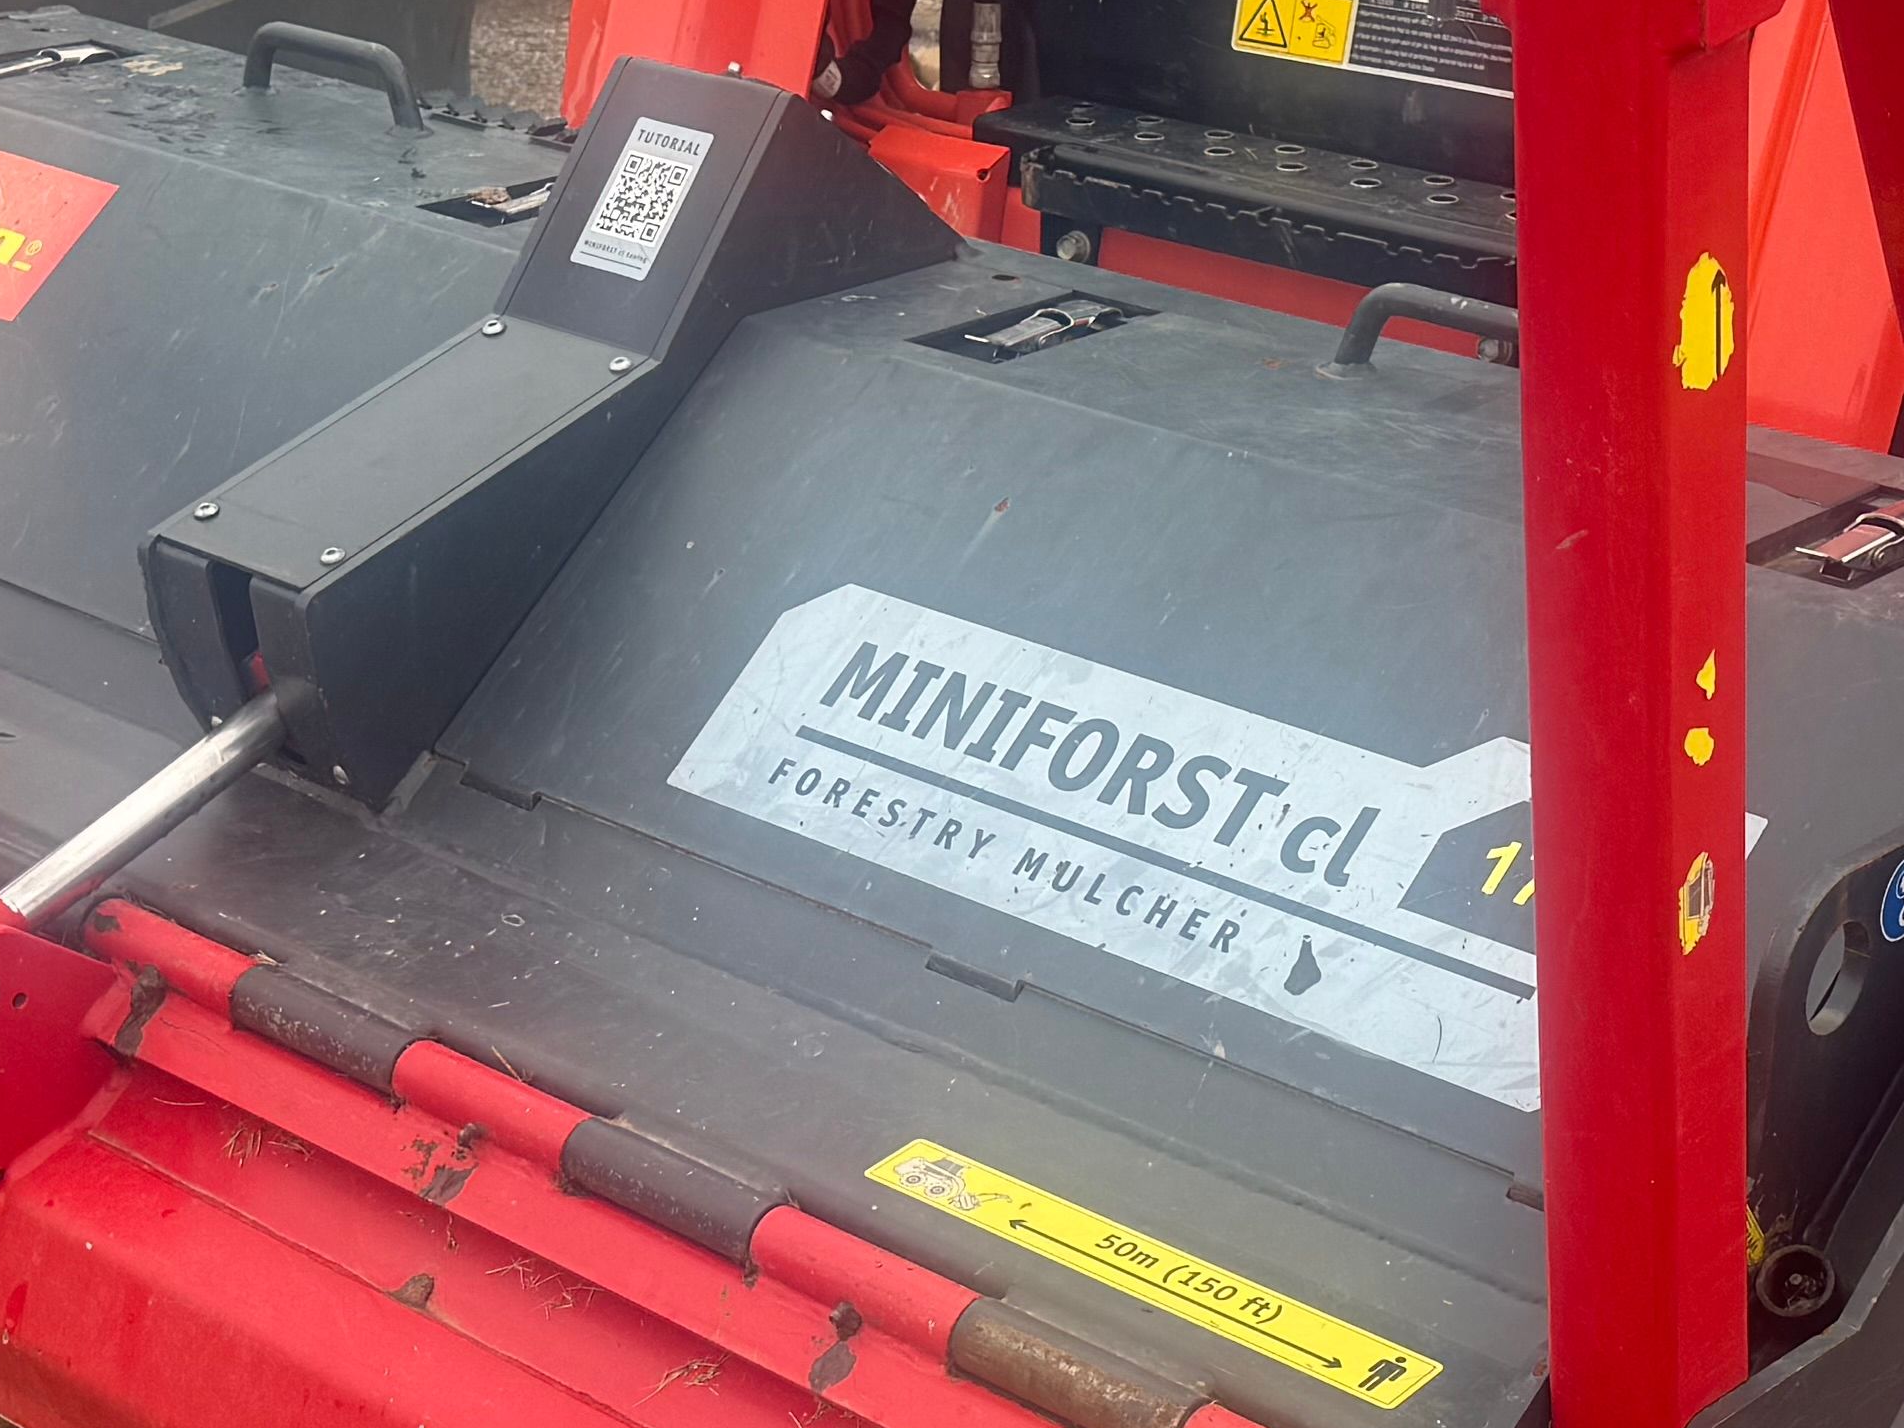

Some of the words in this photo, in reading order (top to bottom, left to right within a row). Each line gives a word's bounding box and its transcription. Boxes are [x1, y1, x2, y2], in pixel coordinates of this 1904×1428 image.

[637, 129, 701, 156] TUTORIAL
[819, 641, 1291, 847] MINIFORST
[1279, 806, 1382, 888] cl
[767, 757, 996, 860] FORESTRY
[1012, 846, 1241, 954] MULCHER
[1095, 1233, 1160, 1271] 50m
[1162, 1263, 1240, 1303] (150
[1244, 1294, 1283, 1326] ft)
